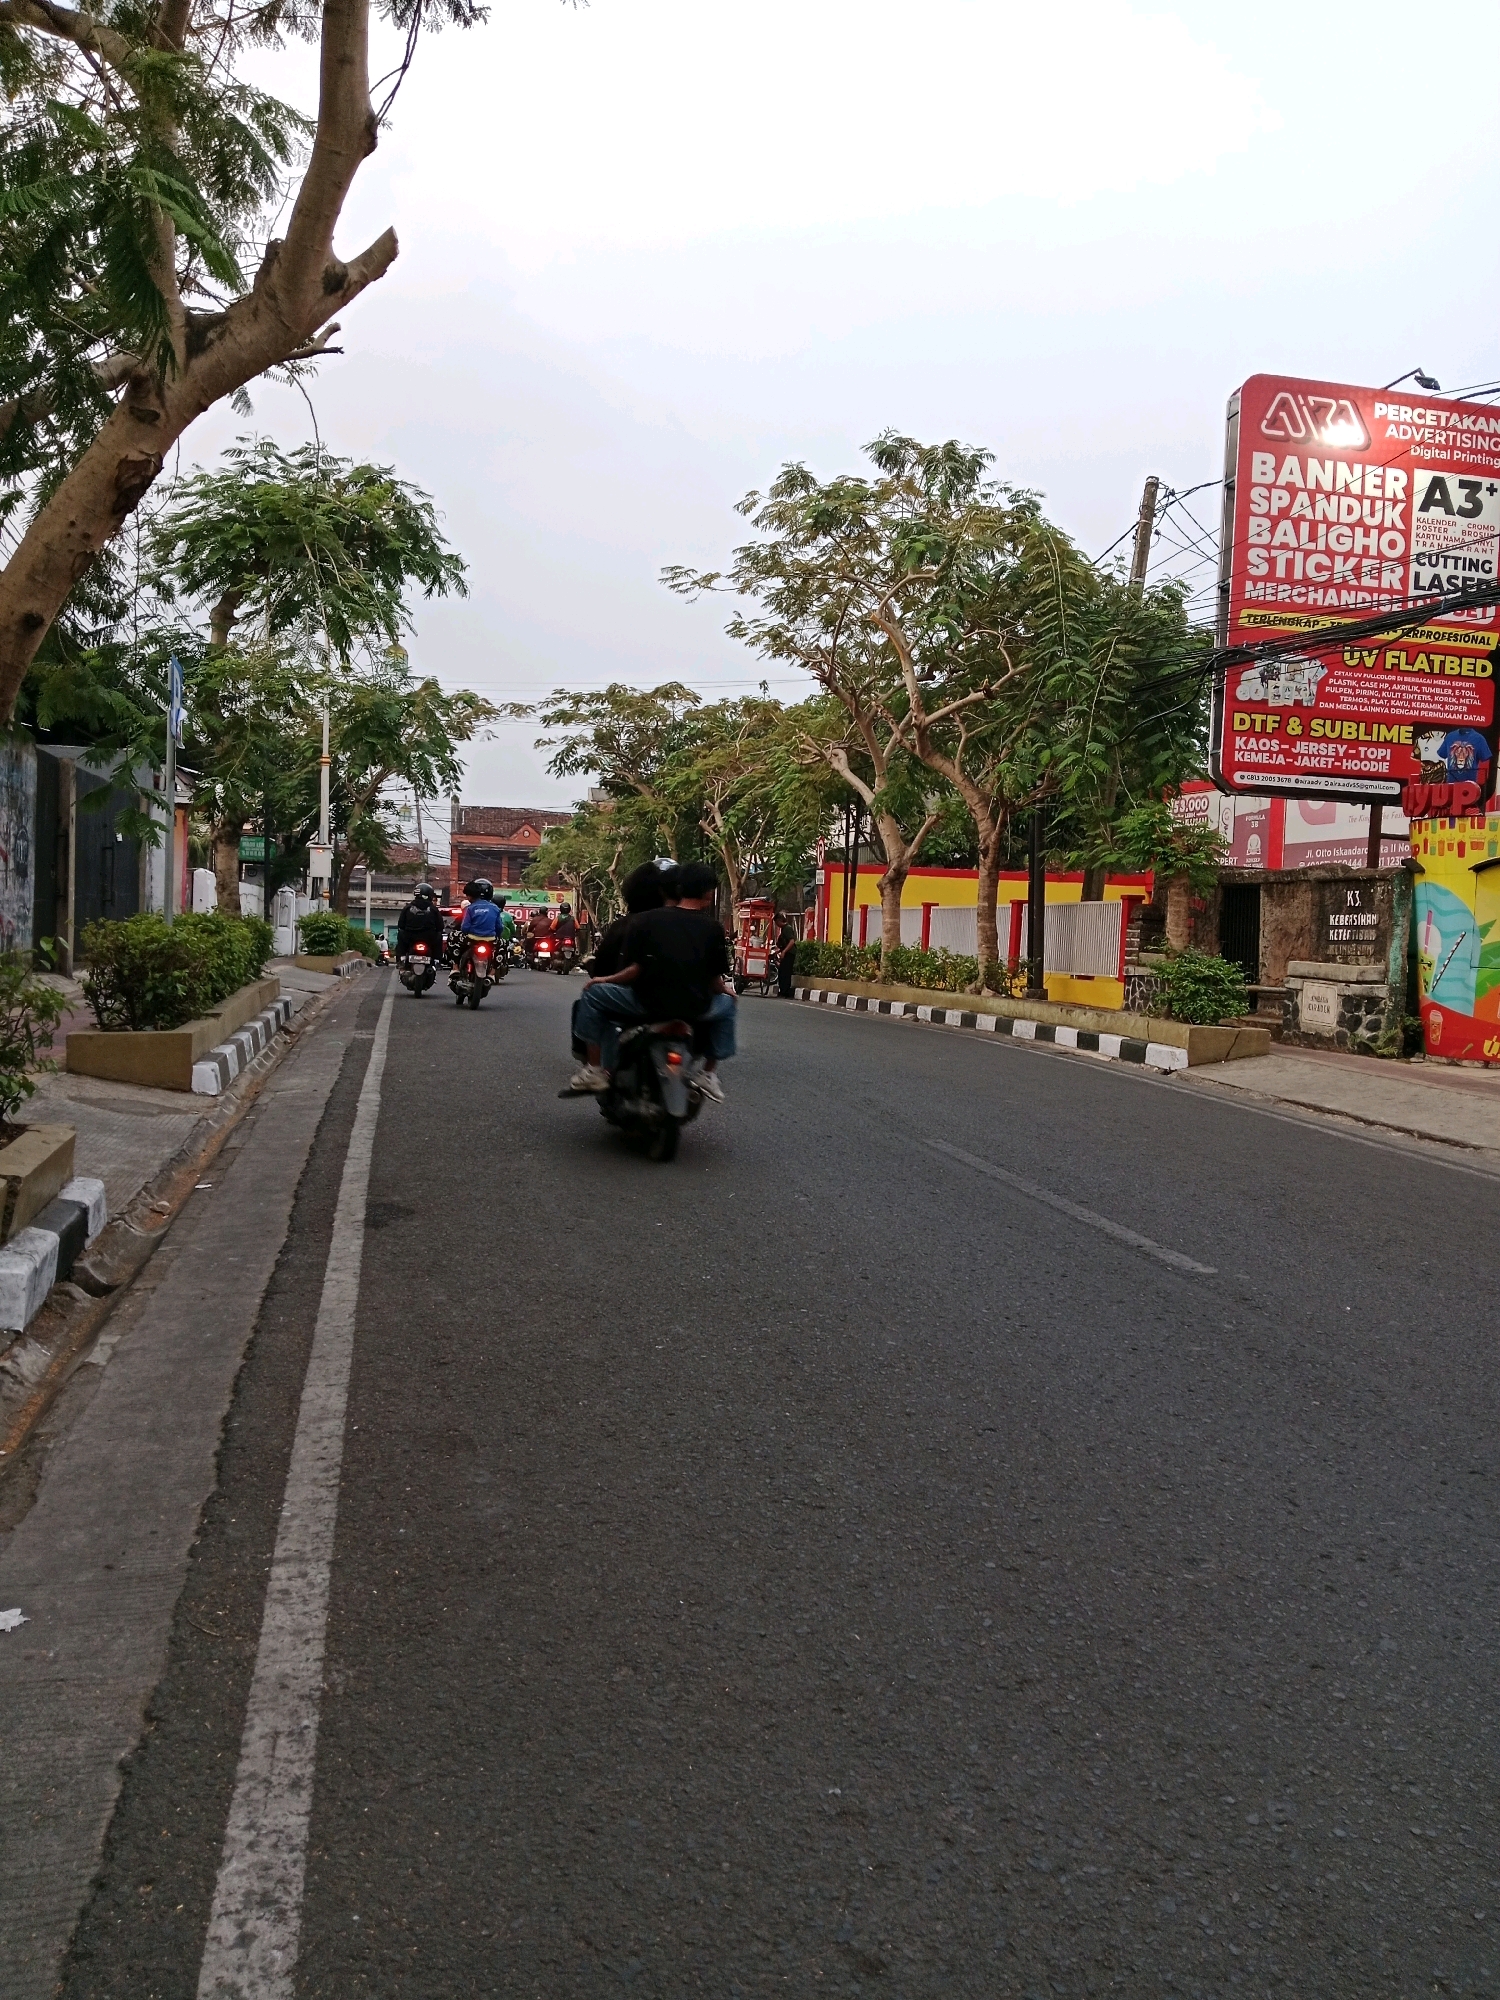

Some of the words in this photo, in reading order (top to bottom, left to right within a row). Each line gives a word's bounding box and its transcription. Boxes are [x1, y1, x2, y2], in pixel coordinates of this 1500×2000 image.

[1374, 402, 1500, 434] PERCETAKAN
[1385, 424, 1500, 451] ADVERTISING
[1410, 445, 1450, 460] Digital
[1453, 450, 1500, 468] Printing
[1251, 451, 1408, 501] BANNER
[1250, 486, 1406, 529] SPANDUK
[1416, 517, 1457, 527] KALENDER
[1467, 523, 1495, 532] CROMO
[1416, 525, 1448, 533] POSTER
[1247, 516, 1406, 558] BALIGHO
[1415, 532, 1442, 541] KARTU
[1443, 536, 1466, 545] NAMA
[1247, 547, 1403, 590] STICKER
[1416, 552, 1493, 574] CUTTING
[1244, 580, 1402, 612] MERCHANDISE
[1384, 650, 1493, 678] FLATBED
[1360, 681, 1378, 689] CASE
[1381, 691, 1401, 699] KULIT
[1459, 698, 1481, 706] METAL
[1335, 703, 1358, 711] MEDIA
[1359, 705, 1389, 714] LAINNYA
[1390, 707, 1419, 716] DENGAN
[1420, 710, 1462, 720] PERMUKAAN
[1463, 714, 1485, 722] DATAR
[1233, 712, 1280, 733] DTF
[1286, 717, 1303, 736] &
[1310, 718, 1414, 745] SUBLIME
[1235, 736, 1280, 752] KAOS
[1291, 741, 1347, 757] JERSEY
[1358, 746, 1391, 761] TOPI
[1315, 848, 1332, 857] Otto
[1347, 890, 1361, 907] K3
